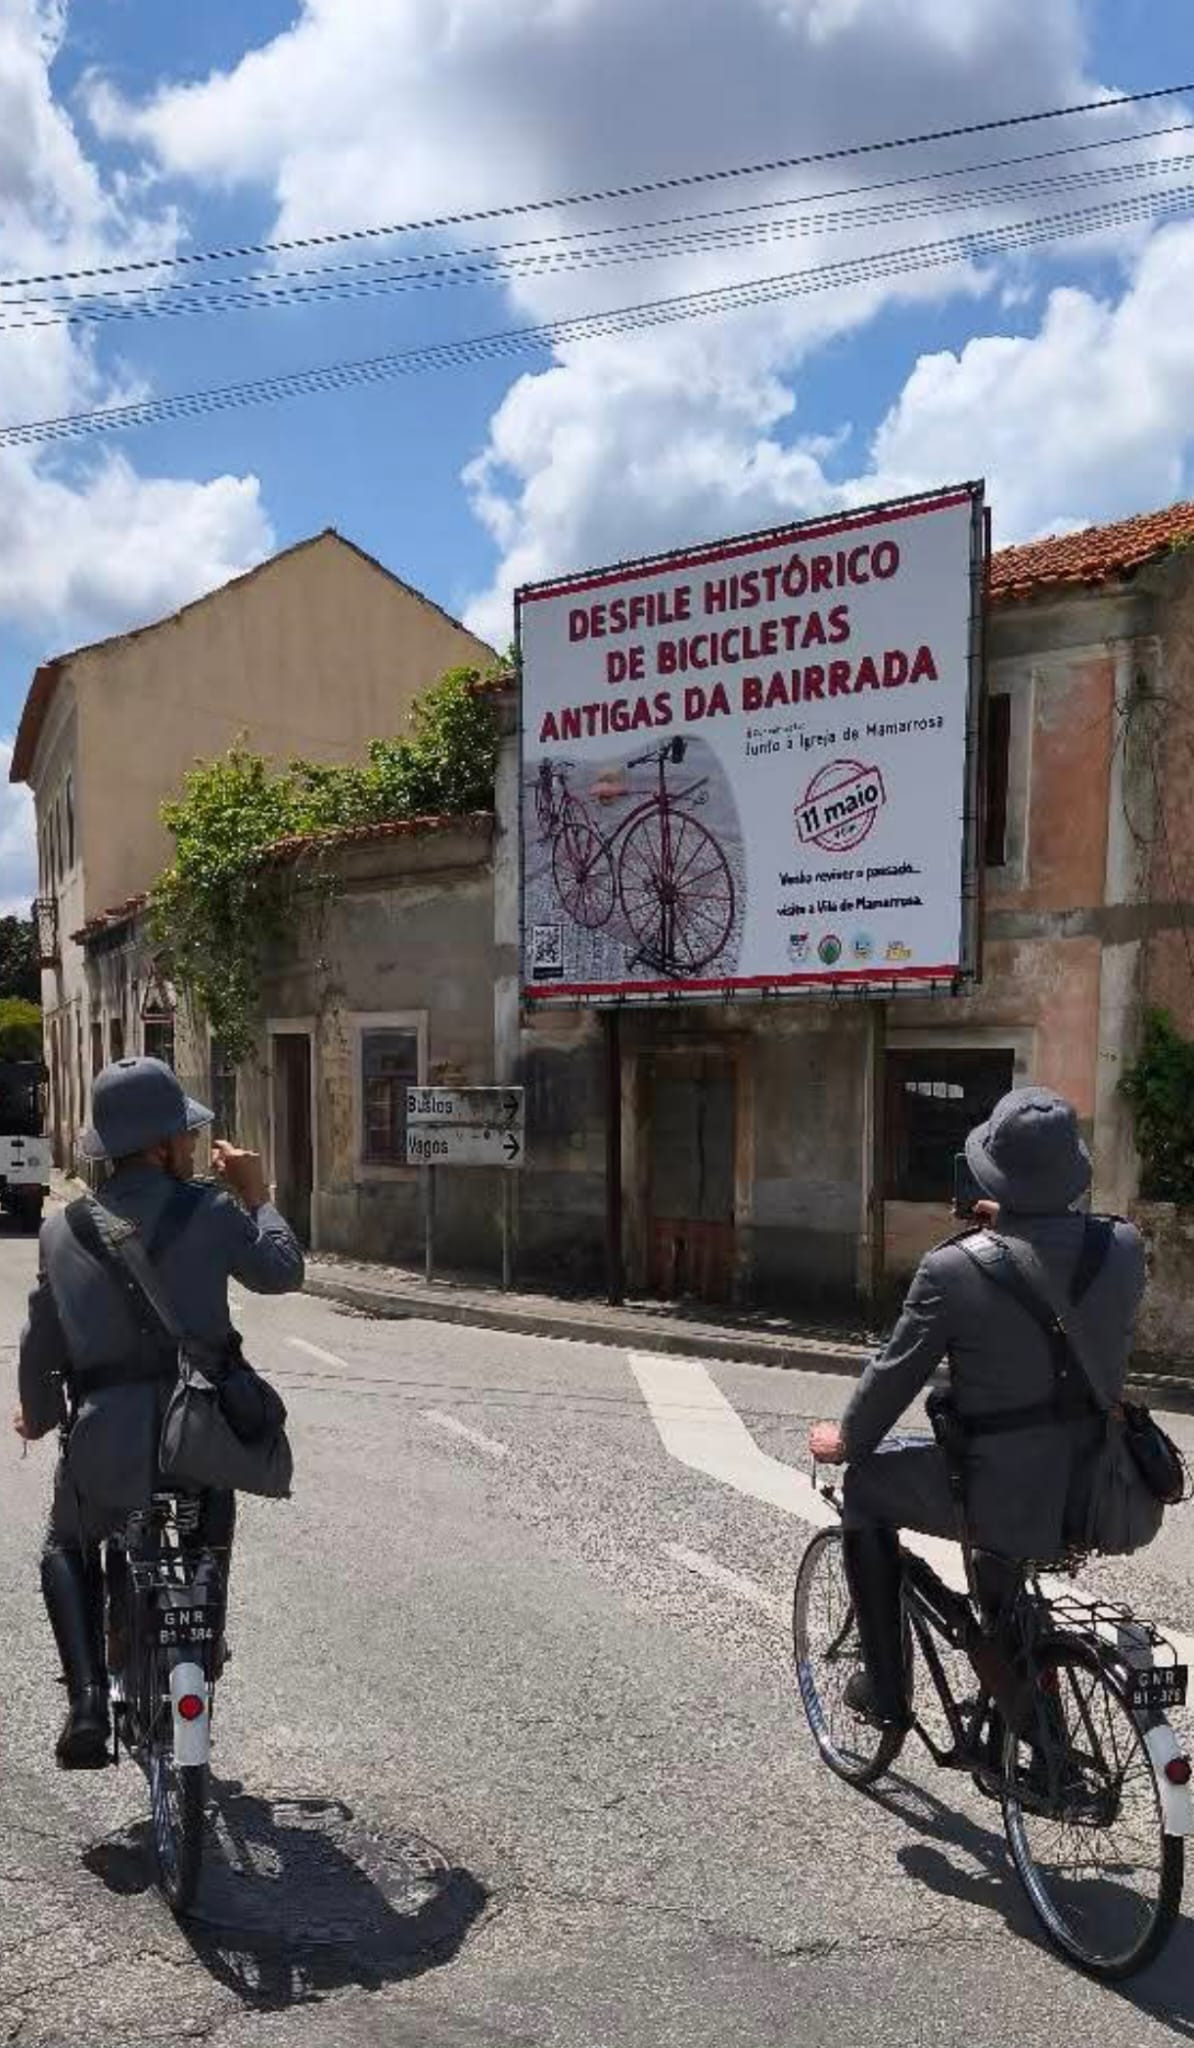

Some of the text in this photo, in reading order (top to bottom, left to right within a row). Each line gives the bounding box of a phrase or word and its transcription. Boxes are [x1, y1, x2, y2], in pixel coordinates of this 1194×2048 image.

[569, 540, 900, 642] DESFILE HISTÓRICO
[607, 604, 850, 684] DE BICICLETAS
[539, 644, 938, 743] ANTIGAS DA BAIRRADA
[842, 727, 860, 742] de
[865, 715, 944, 738] Mamarrosa
[800, 805, 821, 833] 11
[823, 783, 879, 825] maio
[817, 899, 838, 915] Vila
[839, 898, 854, 913] de
[408, 1134, 449, 1158] Vagos
